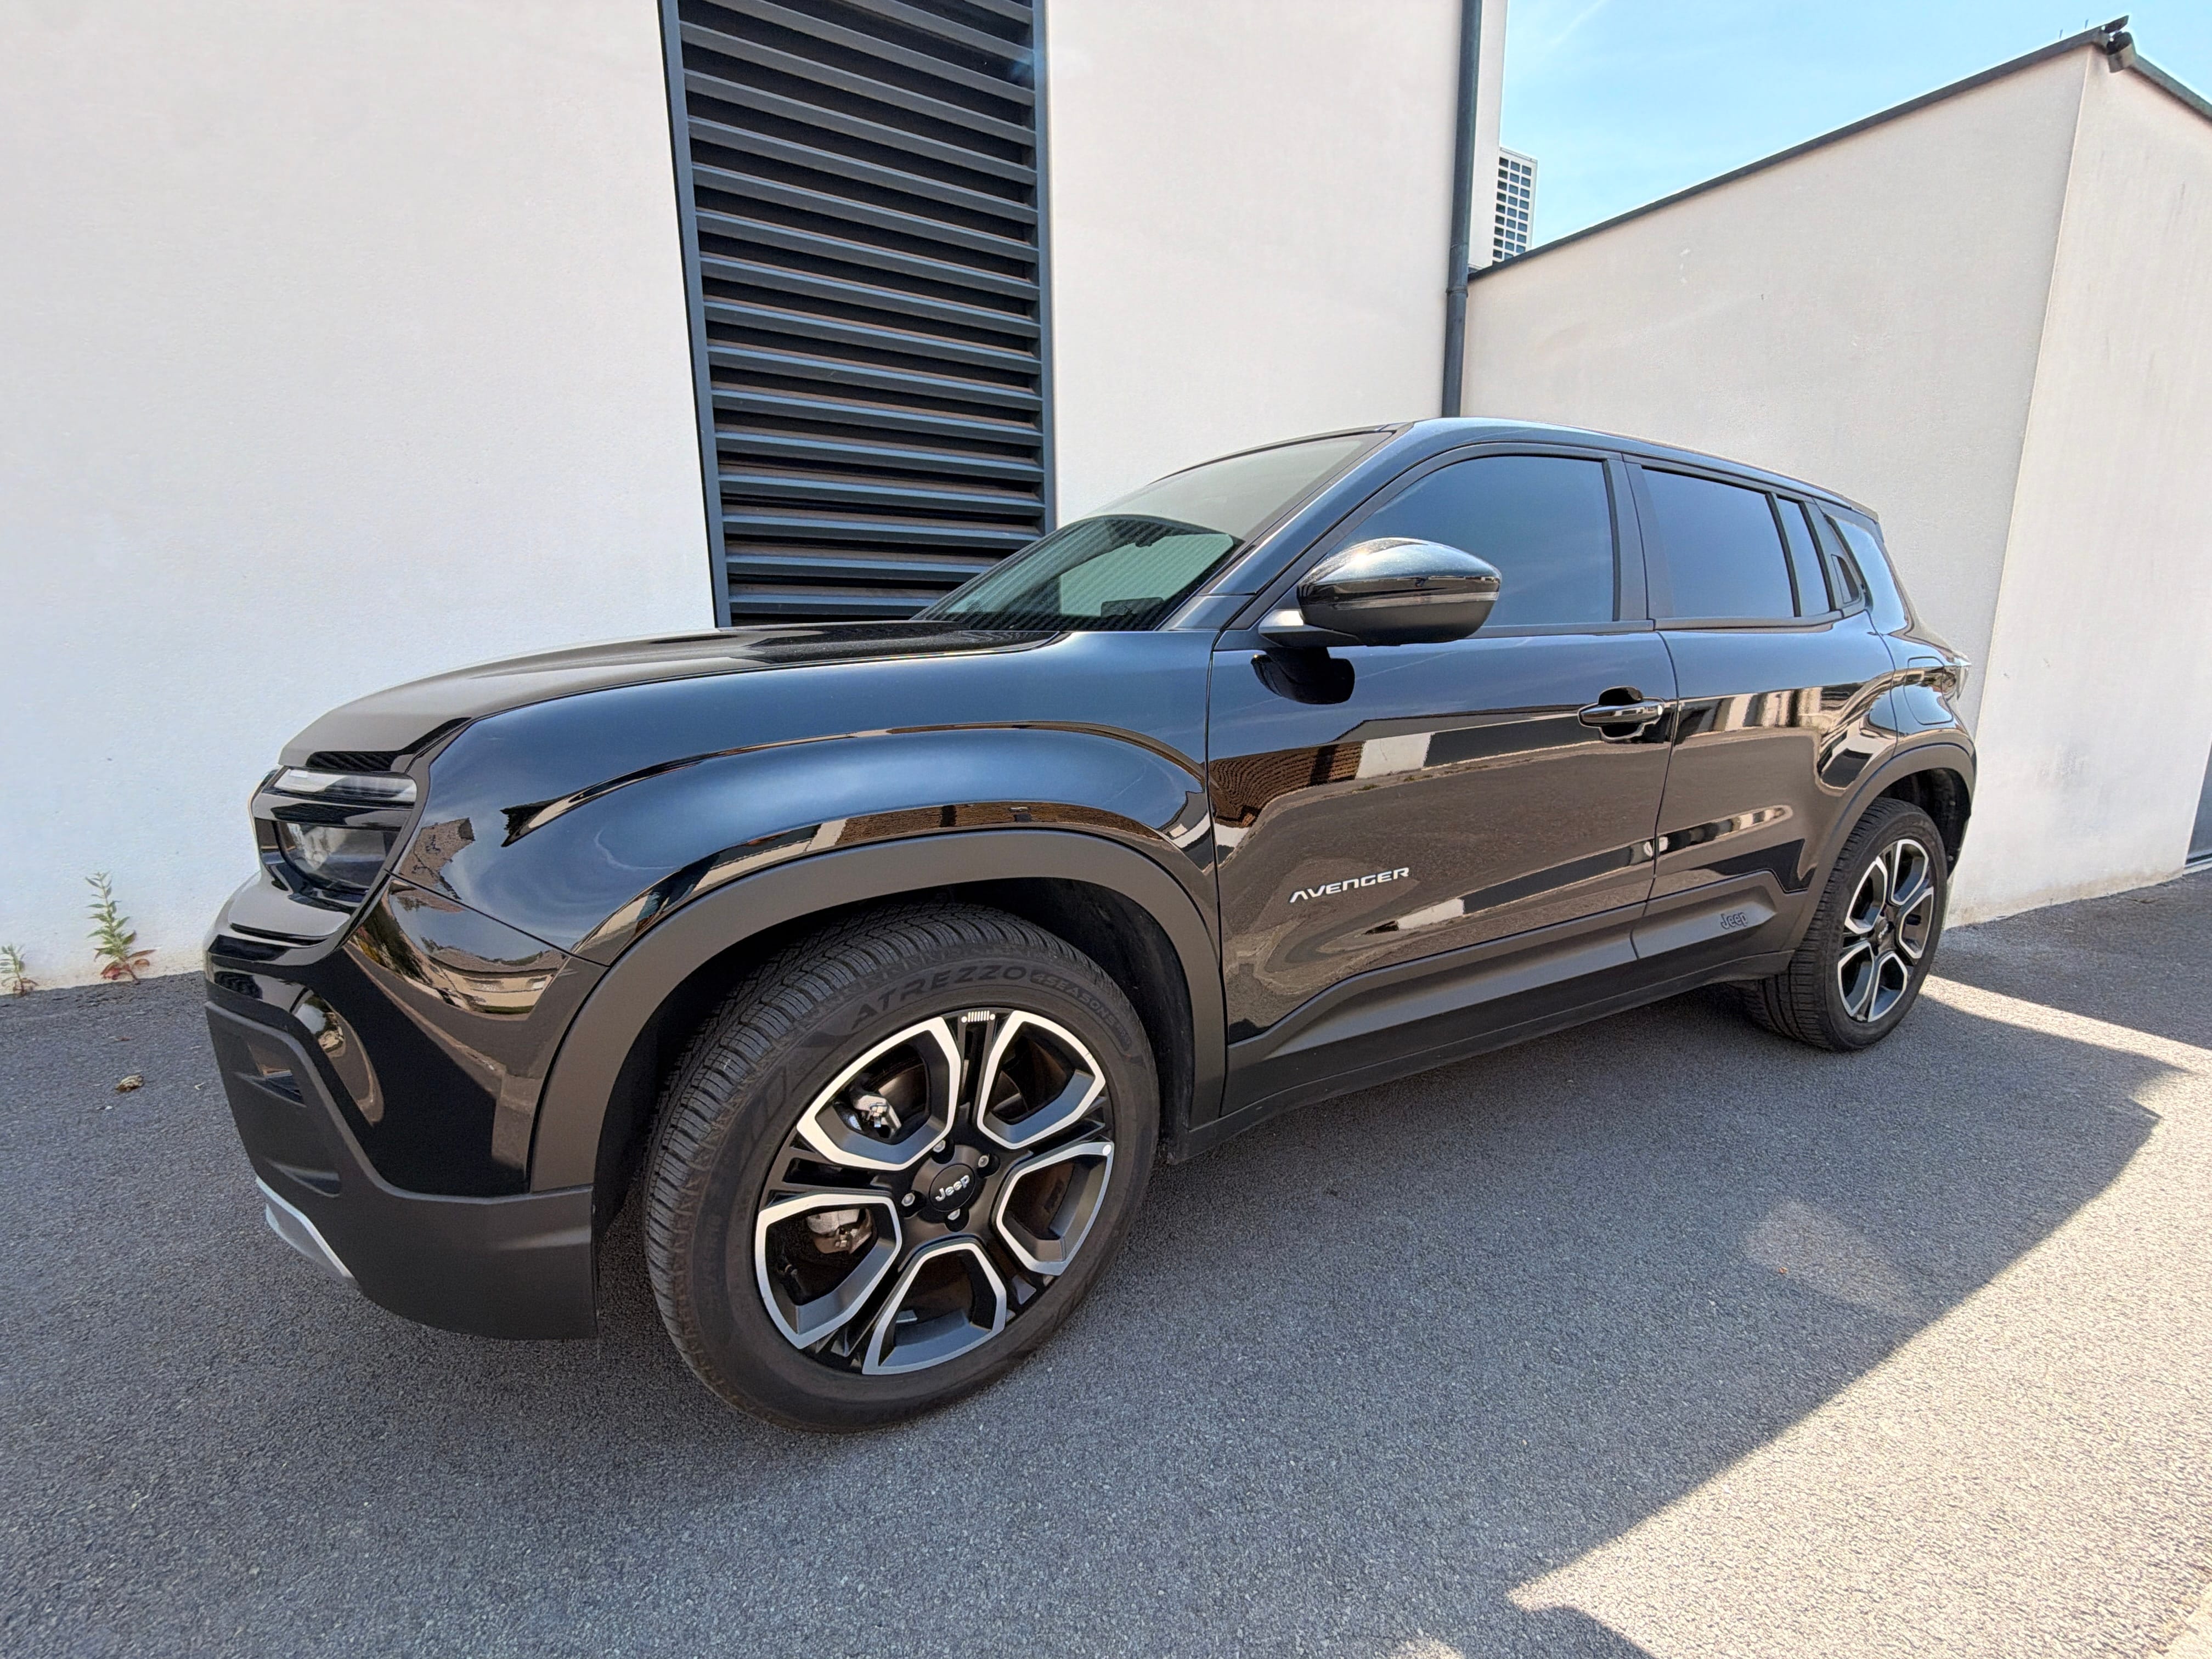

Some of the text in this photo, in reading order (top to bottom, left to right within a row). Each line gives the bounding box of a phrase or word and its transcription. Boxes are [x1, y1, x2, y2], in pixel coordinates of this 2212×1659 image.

[1289, 867, 1409, 903] AVENGER
[1720, 912, 1748, 929] Jeep
[851, 965, 1027, 1030] ATREZZO
[935, 1175, 970, 1201] Jeep
